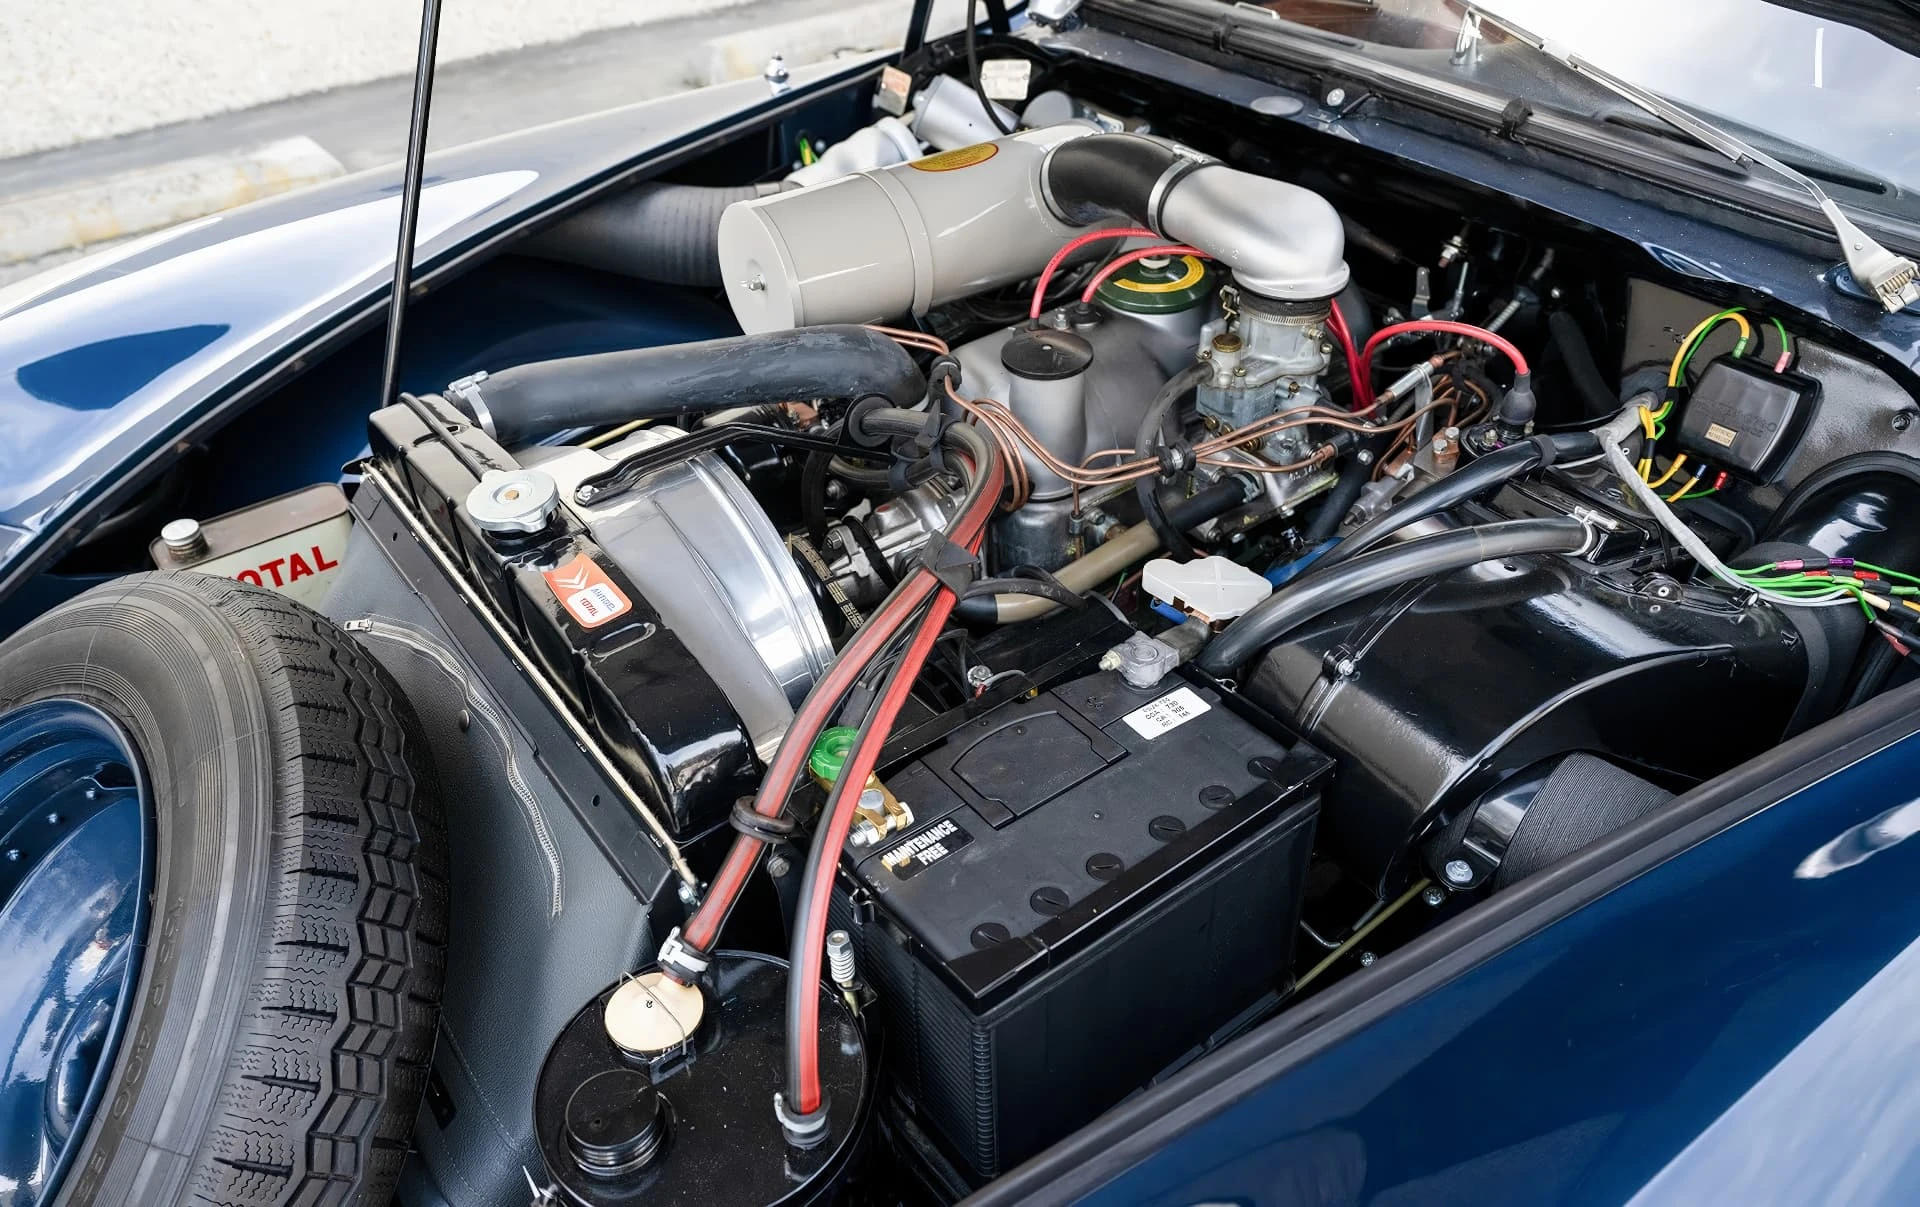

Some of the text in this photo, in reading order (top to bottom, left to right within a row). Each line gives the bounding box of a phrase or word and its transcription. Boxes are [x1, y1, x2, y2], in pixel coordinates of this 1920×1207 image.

[227, 545, 339, 589] OTAL
[580, 597, 601, 617] TOTAL
[882, 819, 959, 869] MAINTENANCE
[916, 842, 949, 866] FREE
